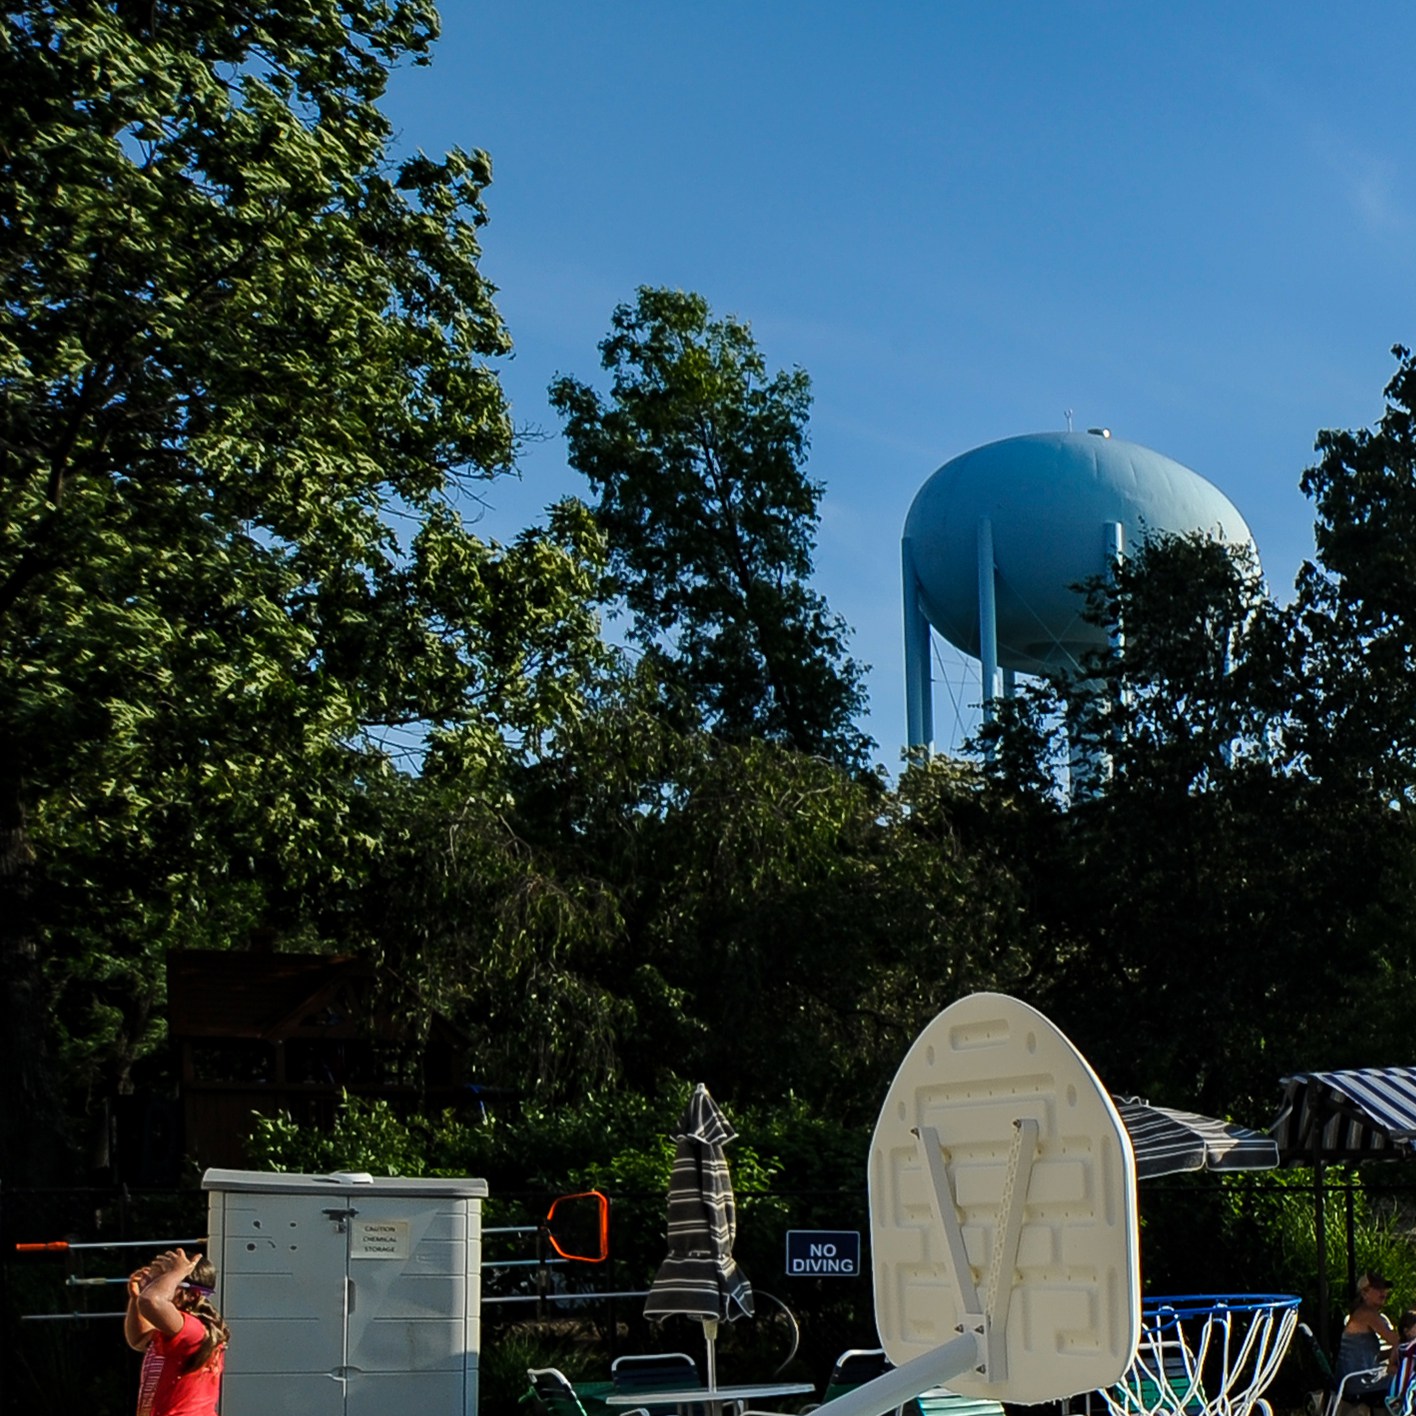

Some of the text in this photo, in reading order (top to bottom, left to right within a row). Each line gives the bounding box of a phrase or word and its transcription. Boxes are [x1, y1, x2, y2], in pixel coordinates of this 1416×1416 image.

[362, 1235, 397, 1243] CHEMICAL
[810, 1243, 837, 1258] NO
[792, 1258, 854, 1273] DIVING
